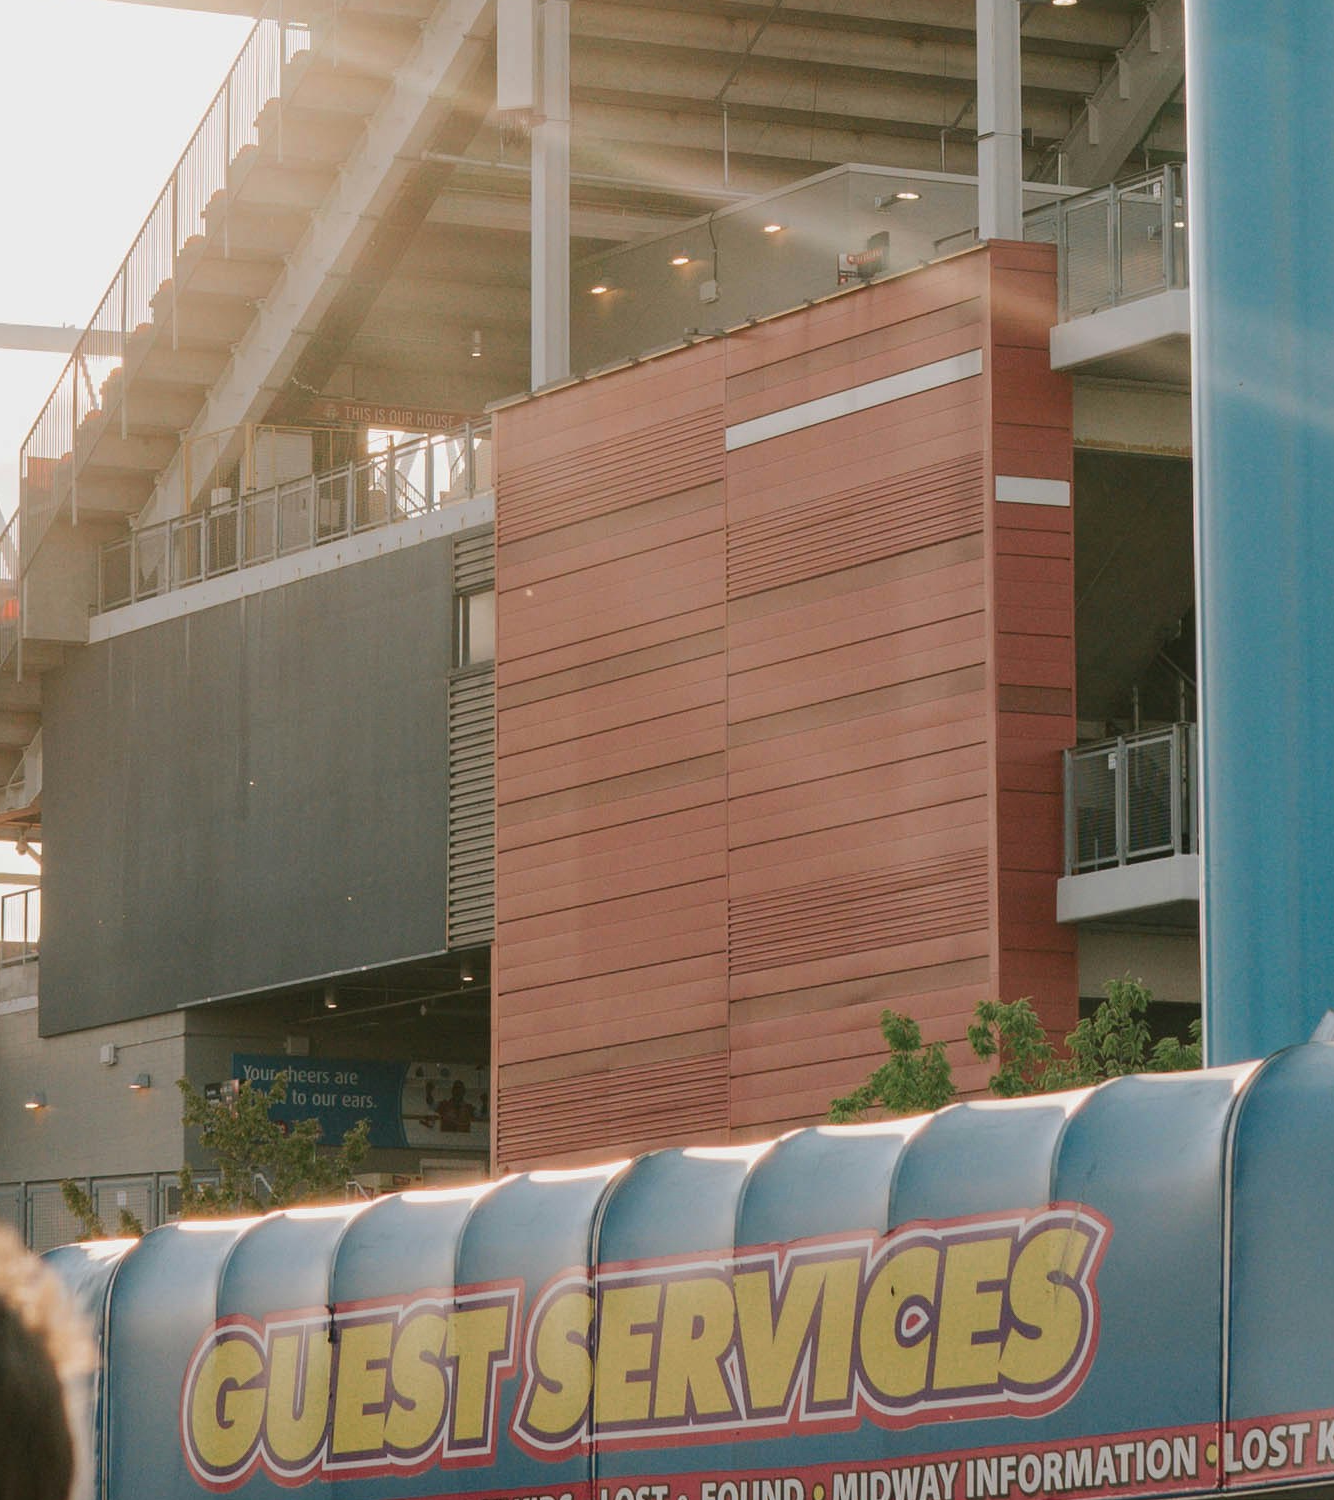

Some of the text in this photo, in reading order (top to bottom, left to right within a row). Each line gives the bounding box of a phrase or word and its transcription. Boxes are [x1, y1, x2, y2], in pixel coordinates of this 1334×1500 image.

[344, 406, 455, 429] THIS IS OUR HOUSE
[242, 1064, 276, 1082] Your
[334, 1071, 359, 1086] are
[292, 1089, 307, 1105] to
[312, 1094, 338, 1106] our
[341, 1095, 378, 1110] ears.
[187, 1223, 1095, 1474] GUEST SERVICES
[966, 1435, 1197, 1500] INFORMATION
[1224, 1422, 1312, 1473] LOST
